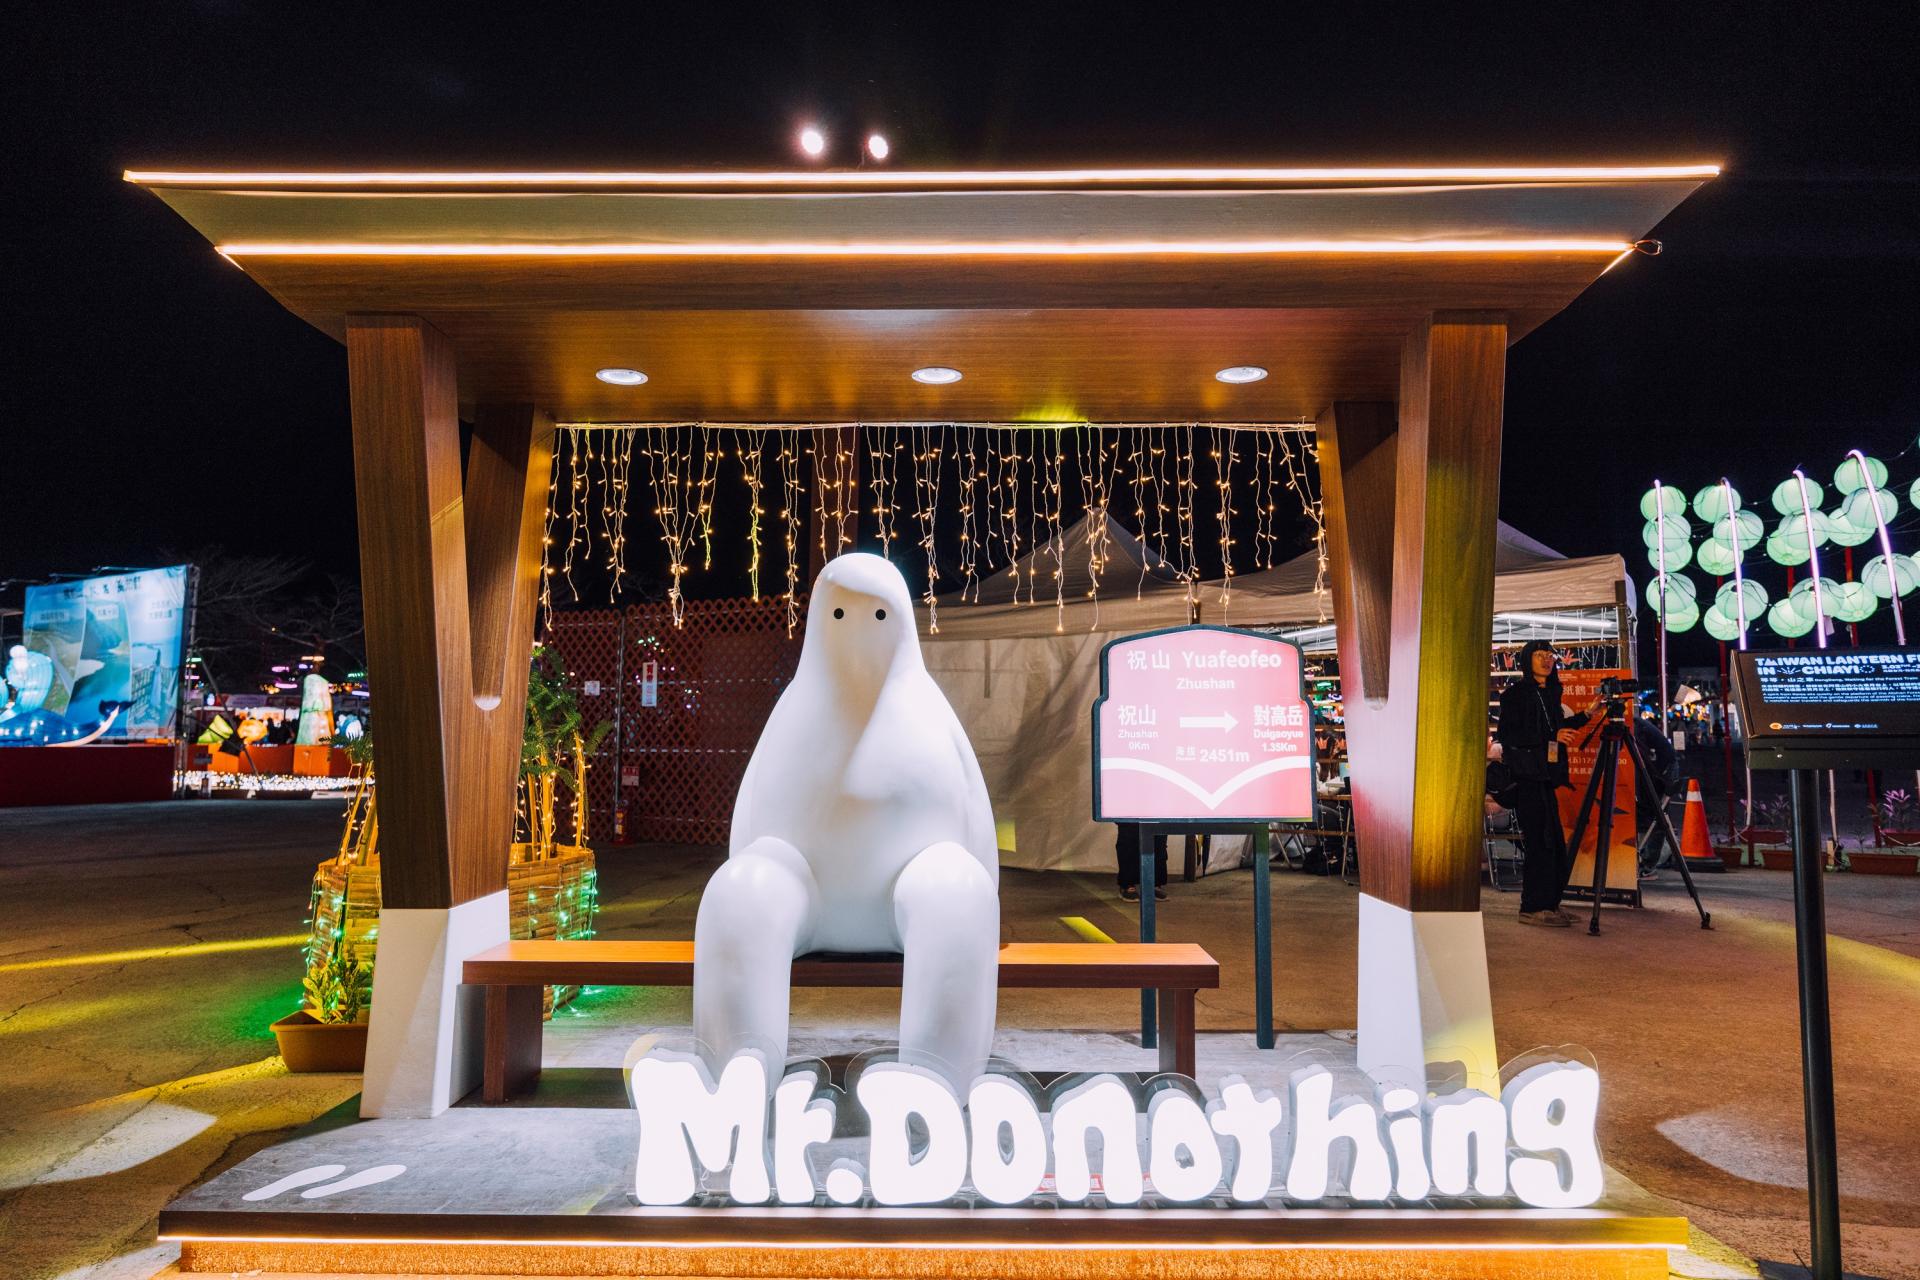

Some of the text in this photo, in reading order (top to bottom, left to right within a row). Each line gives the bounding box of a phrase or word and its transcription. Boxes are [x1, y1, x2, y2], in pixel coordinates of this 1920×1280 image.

[1127, 649, 1282, 670] 祝山 Yuafeofeo
[1755, 656, 1823, 666] TAIWAN
[1825, 654, 1905, 665] LANTERN
[1757, 665, 1860, 675] IN CHIAYI
[1176, 677, 1235, 690] Zhushan
[1117, 704, 1157, 726] 祝山
[1253, 704, 1304, 727] 對高岳
[1118, 729, 1159, 738] Zhushan
[1199, 748, 1250, 763] 2451m
